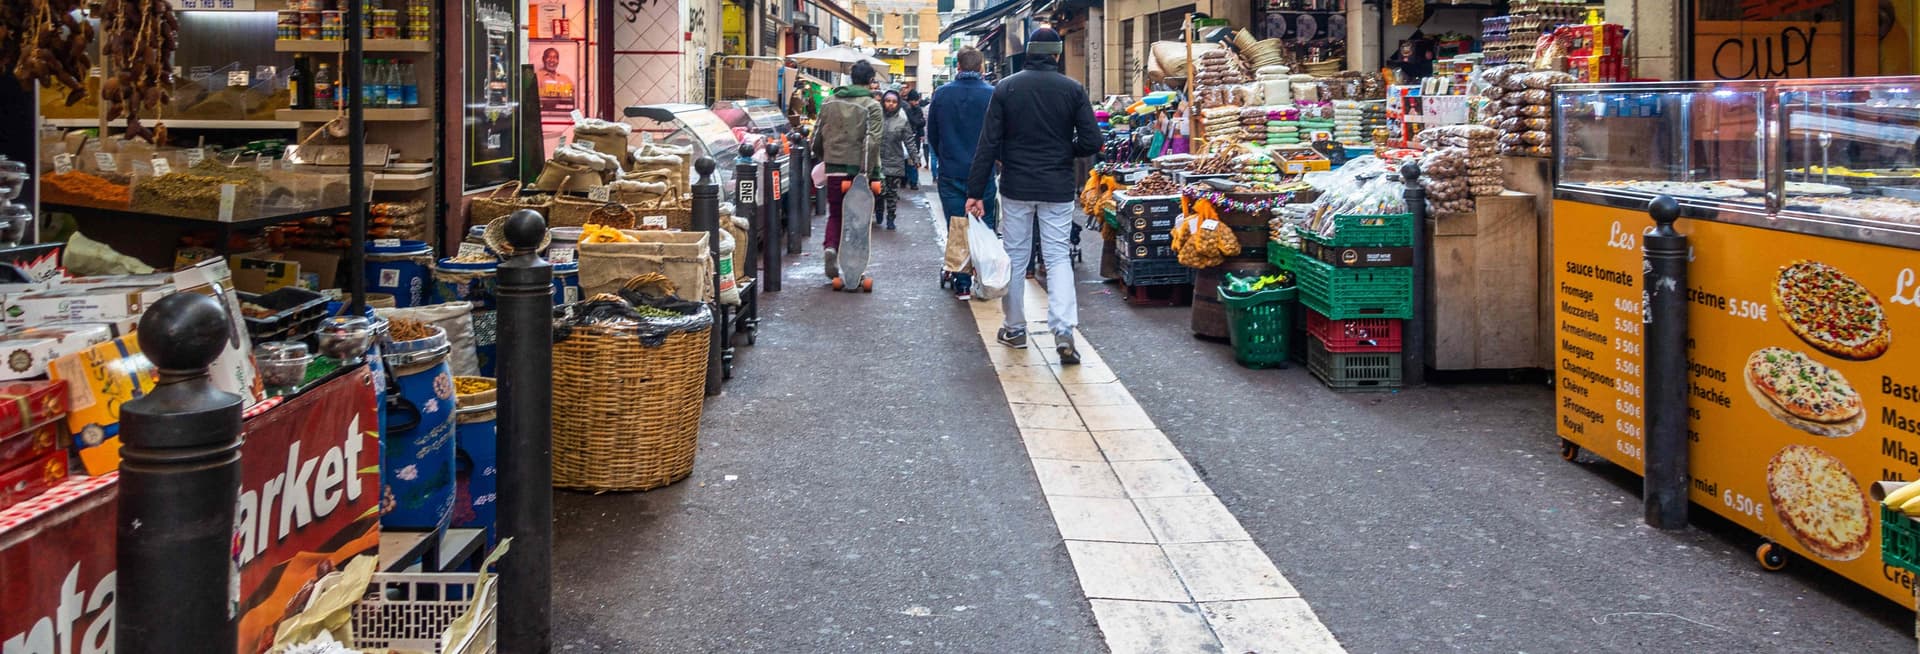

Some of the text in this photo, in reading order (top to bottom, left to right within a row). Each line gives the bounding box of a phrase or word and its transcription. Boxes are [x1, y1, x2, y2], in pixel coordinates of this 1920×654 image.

[741, 182, 753, 202] BNE
[1608, 221, 1636, 250] Les
[1566, 261, 1633, 287] sauce tomate
[1561, 281, 1593, 303] Fromage
[1686, 284, 1768, 322] crème 5.50€
[1562, 339, 1594, 361] Merguez
[1562, 358, 1615, 388] Champignons
[1694, 381, 1731, 408] hachée
[1882, 375, 1920, 403] Bast
[1562, 396, 1604, 424] 3Fromages
[1563, 415, 1585, 434] Royal
[1882, 437, 1920, 473] Mha
[1694, 477, 1717, 497] miel
